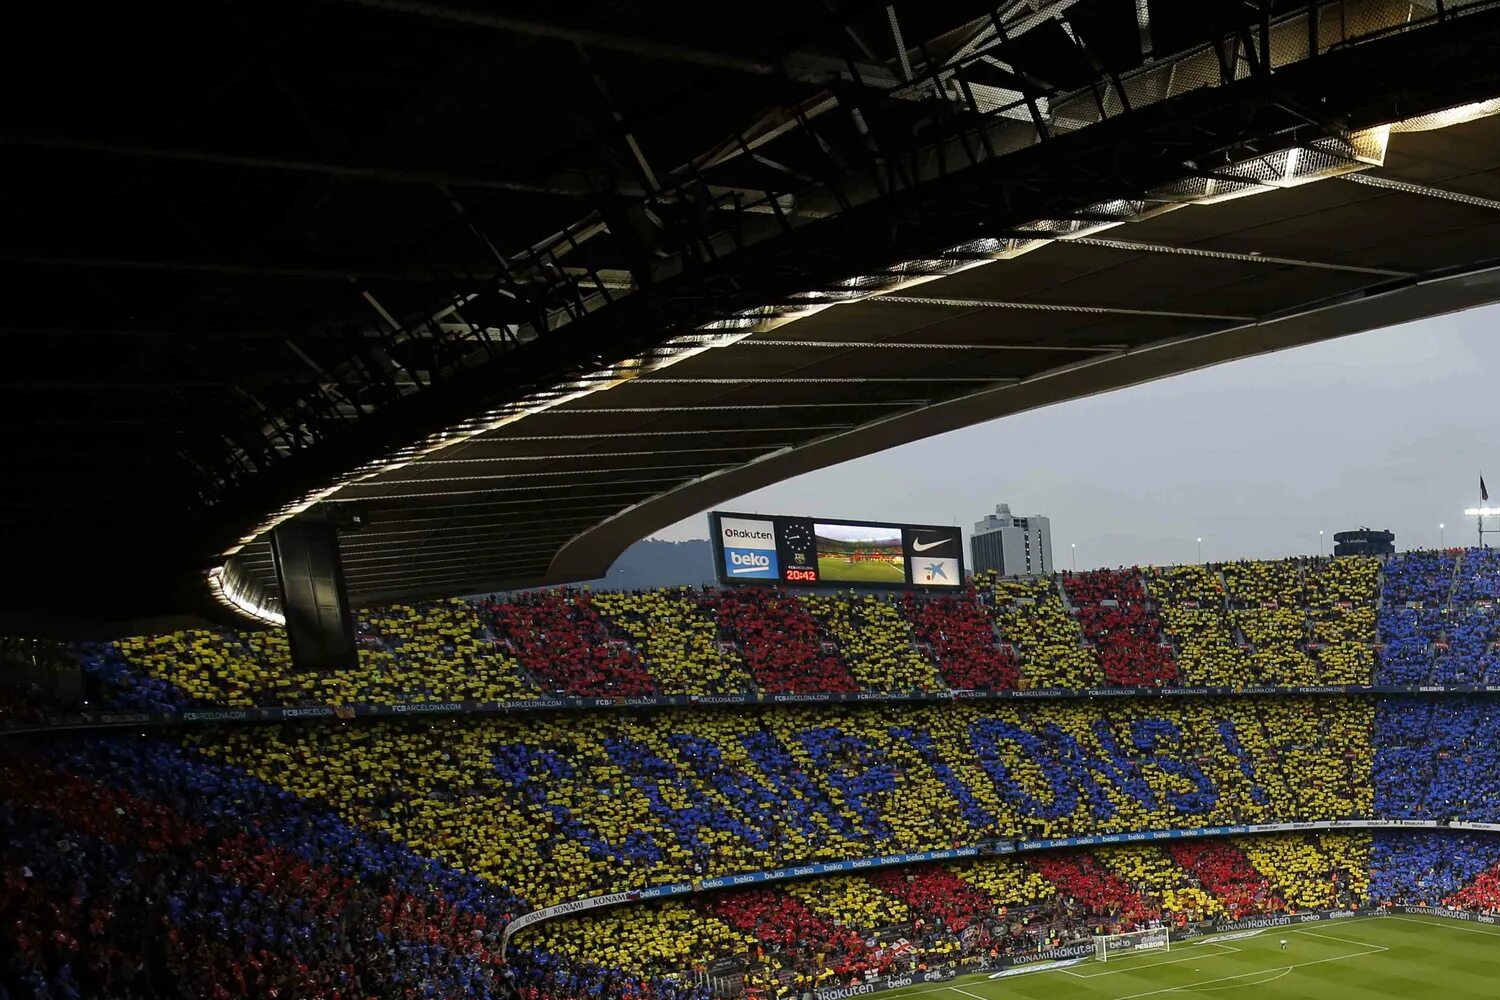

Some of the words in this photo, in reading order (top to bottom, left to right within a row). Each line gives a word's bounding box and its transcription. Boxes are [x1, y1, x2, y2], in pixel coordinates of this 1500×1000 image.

[733, 529, 773, 540] Rakuten
[731, 552, 769, 566] beko
[786, 570, 816, 581] 20:42
[392, 703, 462, 712] FCBARCELONA.COM
[1023, 841, 1041, 849] beko
[1076, 837, 1094, 845] beko
[881, 856, 900, 864] beko
[905, 853, 925, 861] beko
[823, 863, 843, 871] beko
[852, 859, 871, 867] beko
[794, 866, 814, 875] beko
[702, 879, 723, 887] beko
[734, 874, 754, 883] beko
[671, 884, 692, 893] beko
[639, 889, 660, 898] beko
[553, 902, 584, 915] KONAMI
[1405, 907, 1435, 915] KONAMI
[1301, 913, 1320, 923] beko
[1330, 910, 1355, 919] Gillette
[1437, 908, 1470, 920] Rakuten
[1251, 916, 1291, 929] Rakuten
[1478, 915, 1494, 924] beko
[1216, 920, 1249, 932] KONAMI
[1054, 942, 1096, 958] Rakuten
[1013, 949, 1049, 965] KONAMI
[887, 976, 912, 988] beko
